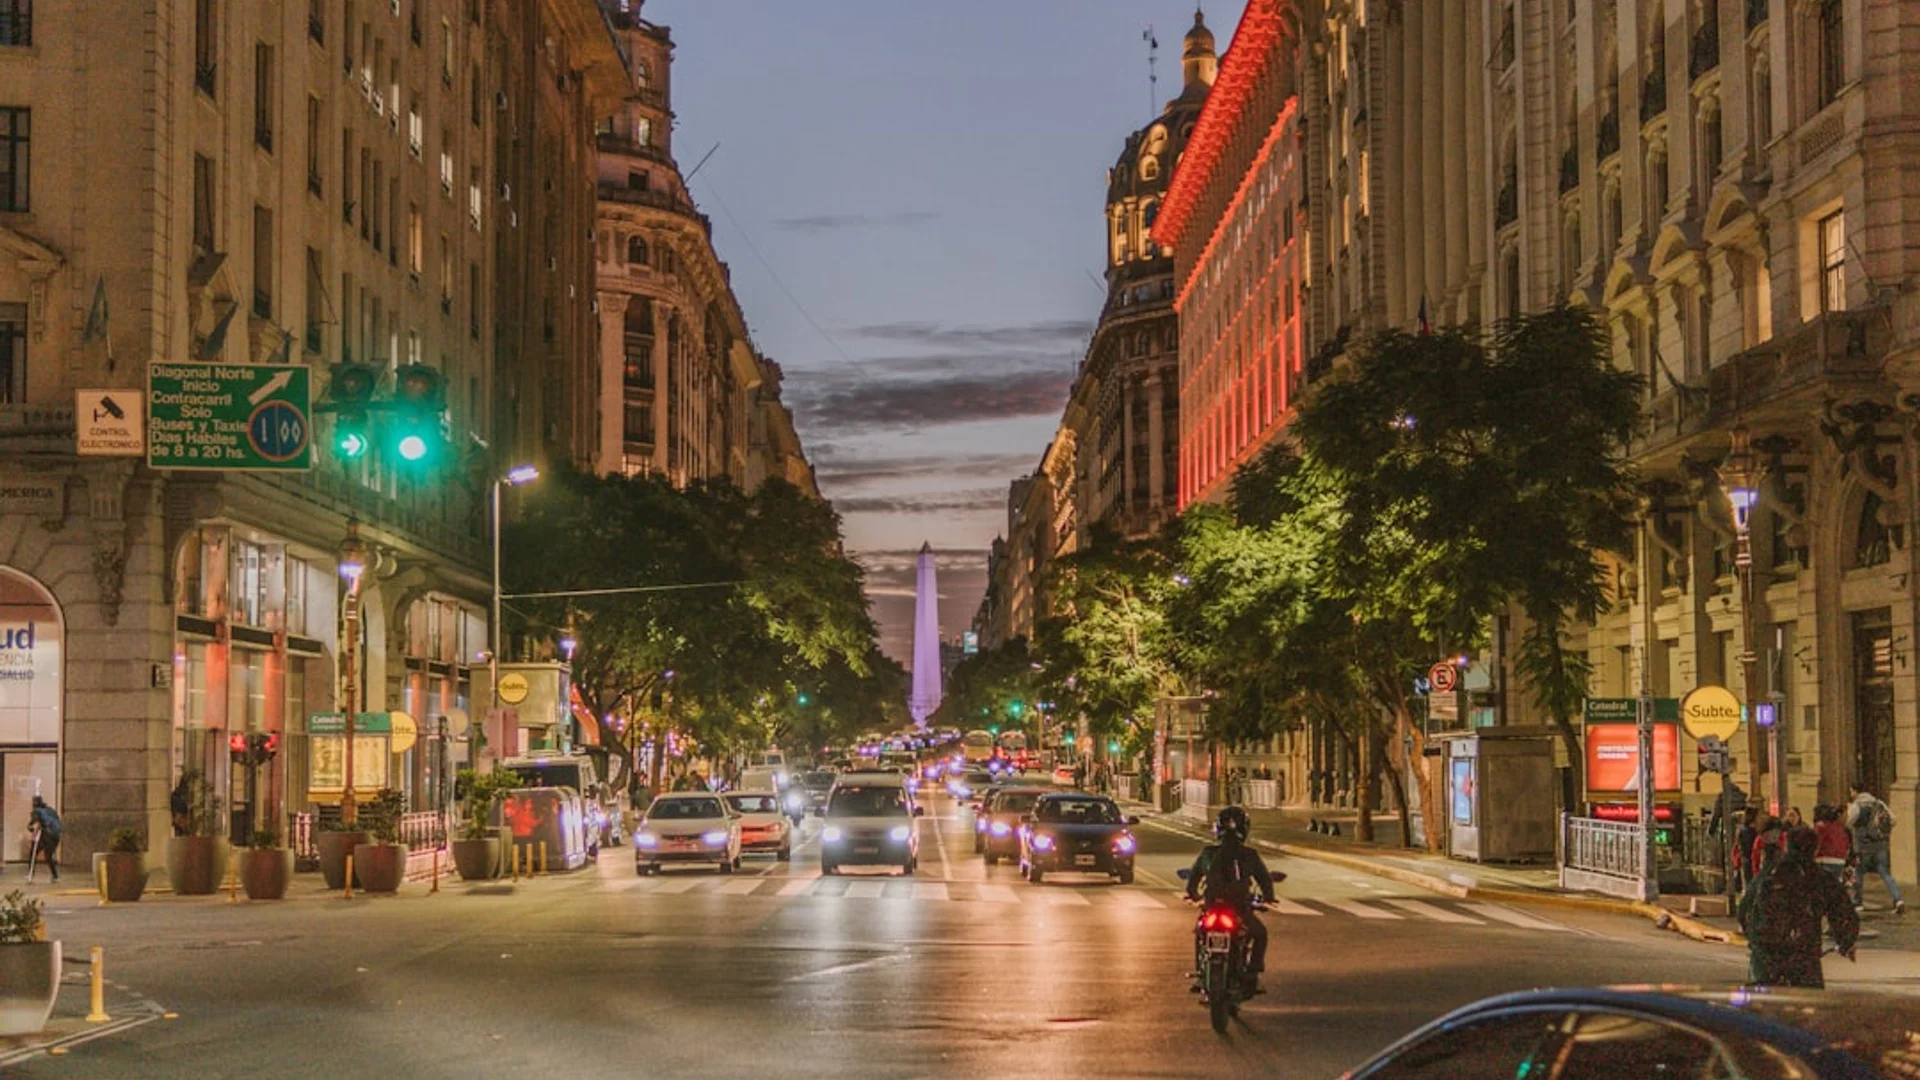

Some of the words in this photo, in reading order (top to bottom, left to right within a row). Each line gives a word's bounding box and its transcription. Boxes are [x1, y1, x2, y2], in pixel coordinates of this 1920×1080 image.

[152, 365, 211, 380] Diagonal
[215, 367, 255, 380] Norte
[182, 380, 220, 392] Inicio
[180, 405, 212, 418] Solo
[90, 427, 130, 436] CONTROL
[152, 417, 194, 431] Buses
[199, 421, 208, 433] y
[152, 444, 169, 456] de
[174, 445, 184, 457] 8
[189, 448, 198, 457] a
[203, 445, 222, 458] 20
[0, 487, 53, 498] MERICA
[0, 620, 35, 649] ud
[1590, 701, 1628, 711] Catedral
[1692, 704, 1733, 718] Subte
